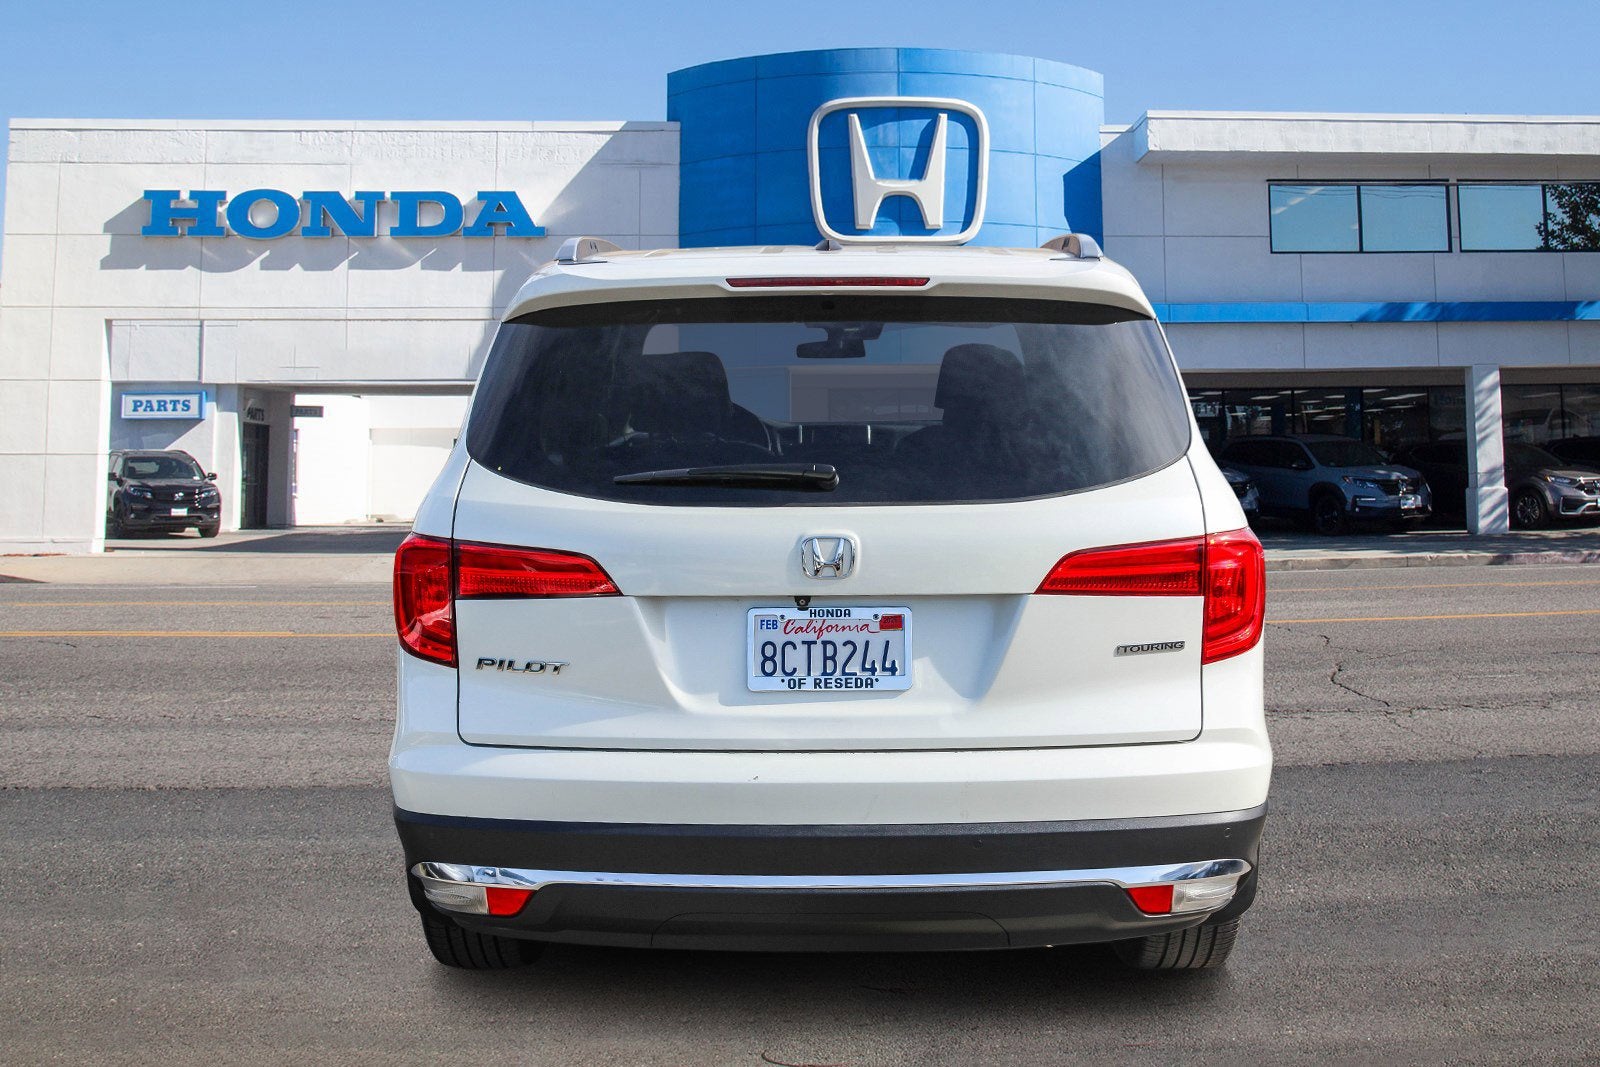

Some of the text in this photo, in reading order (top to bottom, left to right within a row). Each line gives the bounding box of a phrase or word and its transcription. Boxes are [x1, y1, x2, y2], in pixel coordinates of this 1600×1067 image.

[141, 189, 547, 239] HONDA
[132, 399, 191, 412] PARTS
[809, 608, 851, 618] HONDA
[759, 619, 778, 630] FEB
[783, 619, 880, 640] California
[1120, 640, 1184, 653] TOURING
[760, 640, 898, 676] 8CTB244
[476, 657, 570, 675] PILOT
[787, 677, 874, 690] OF RESEDA
